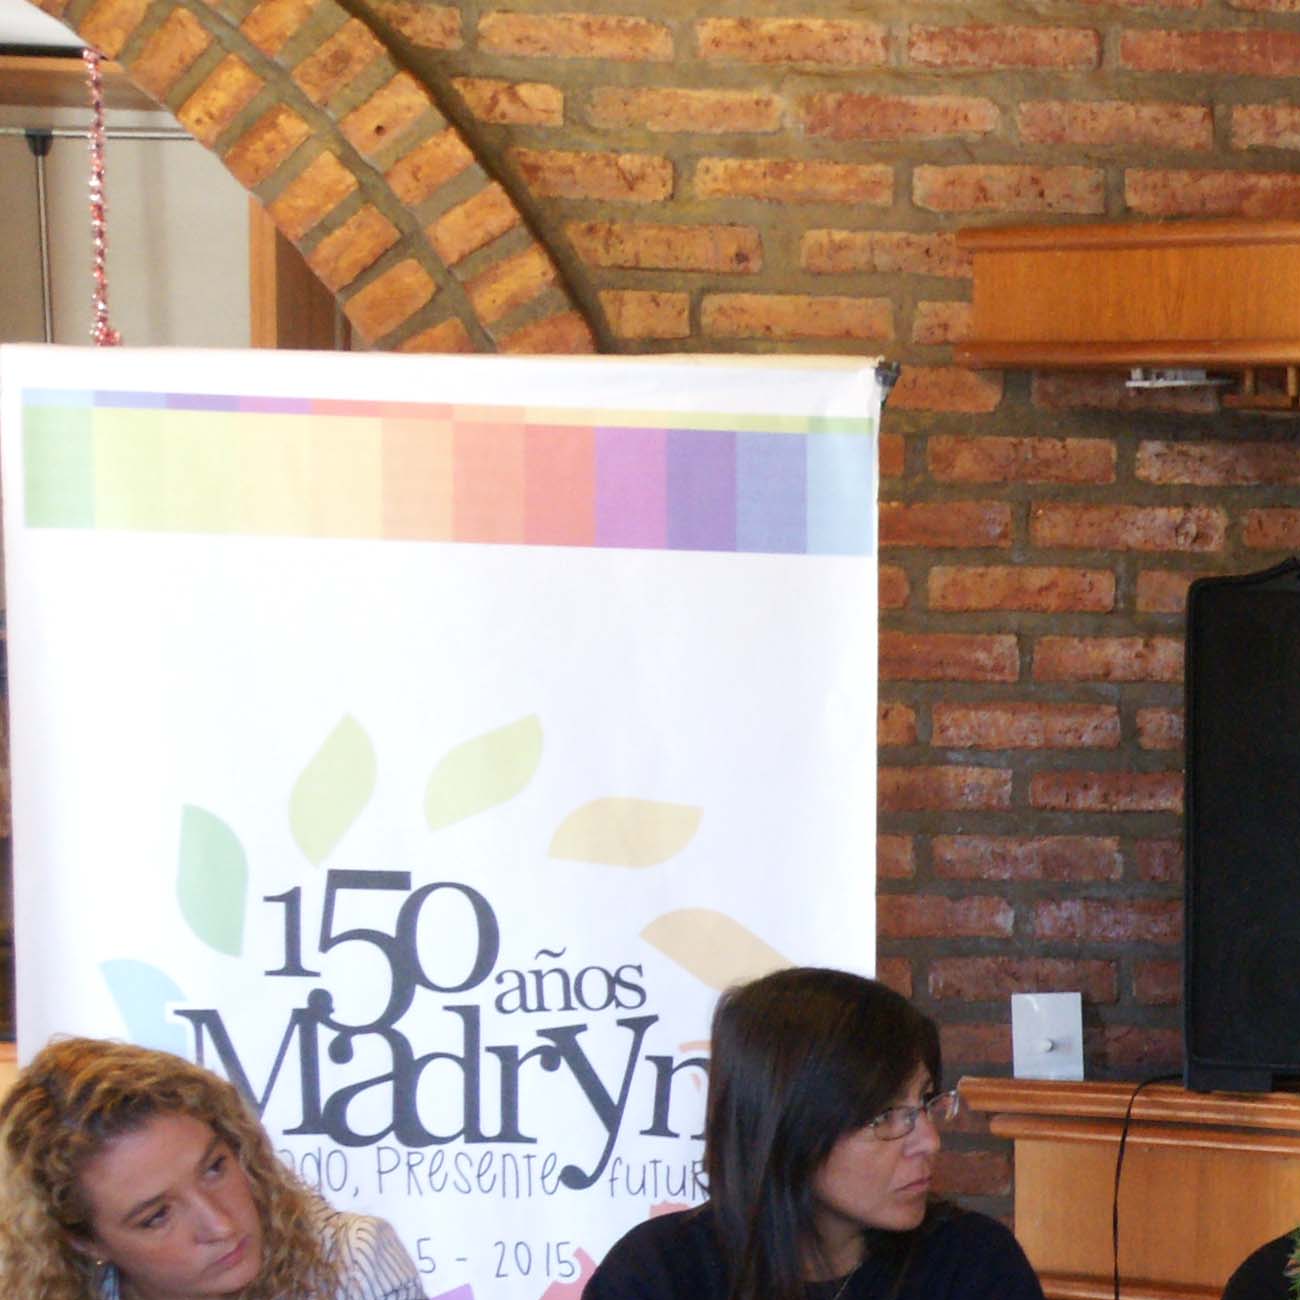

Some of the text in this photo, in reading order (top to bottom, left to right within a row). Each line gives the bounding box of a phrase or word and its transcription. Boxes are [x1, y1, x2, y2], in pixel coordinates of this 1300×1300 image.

[263, 868, 647, 1028] 150 años
[494, 1240, 576, 1278] 2015
